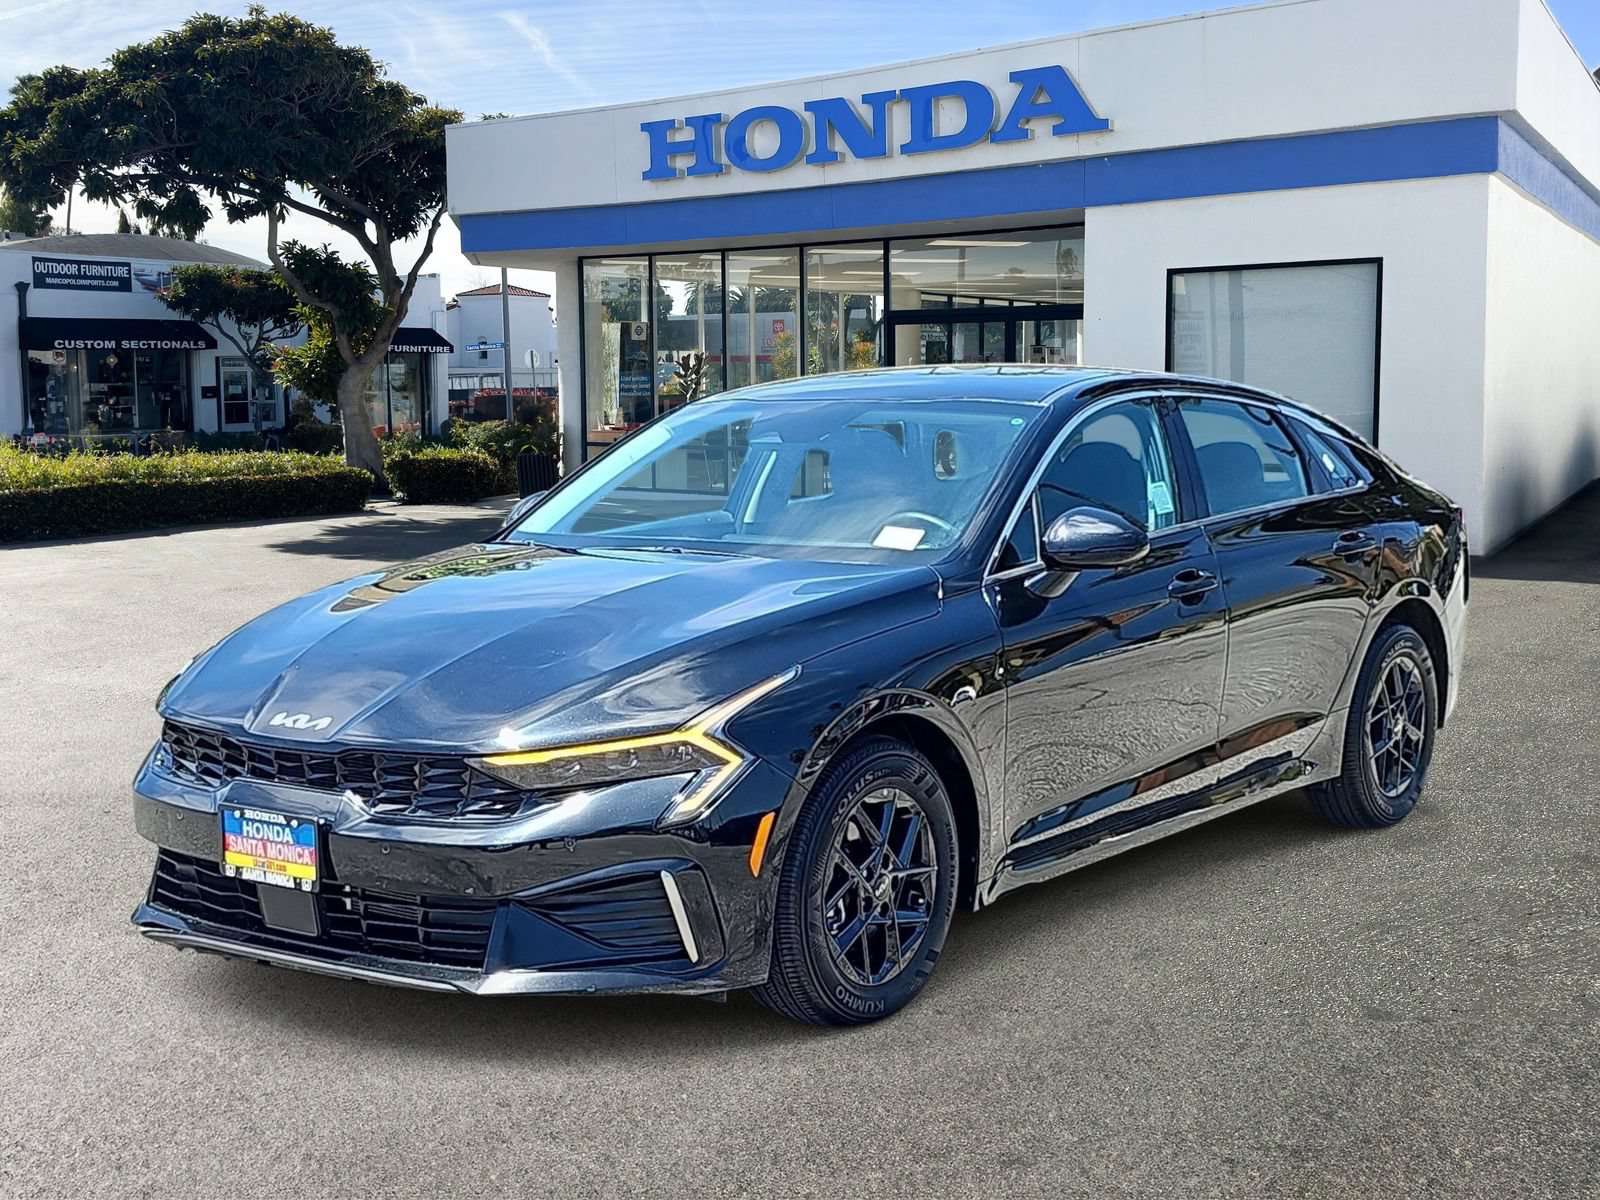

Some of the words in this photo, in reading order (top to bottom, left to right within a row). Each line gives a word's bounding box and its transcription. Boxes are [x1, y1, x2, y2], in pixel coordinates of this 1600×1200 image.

[641, 65, 1112, 182] HONDA
[34, 261, 79, 276] OUTDOOR
[80, 264, 130, 278] FURNITURE
[45, 277, 120, 287] MARCOPOLOIMPORTS.COM
[54, 339, 116, 349] CUSTOM
[121, 340, 206, 349] SECTIONALS
[388, 344, 450, 353] FURNITURE
[831, 770, 874, 828] SOLUS
[243, 809, 288, 825] HONDA
[242, 820, 294, 844] HONDA
[228, 835, 266, 857] SANTA
[266, 840, 313, 865] MONICA
[241, 867, 266, 882] SANTA
[265, 869, 296, 889] MONICA
[835, 985, 885, 1013] KUMHO
